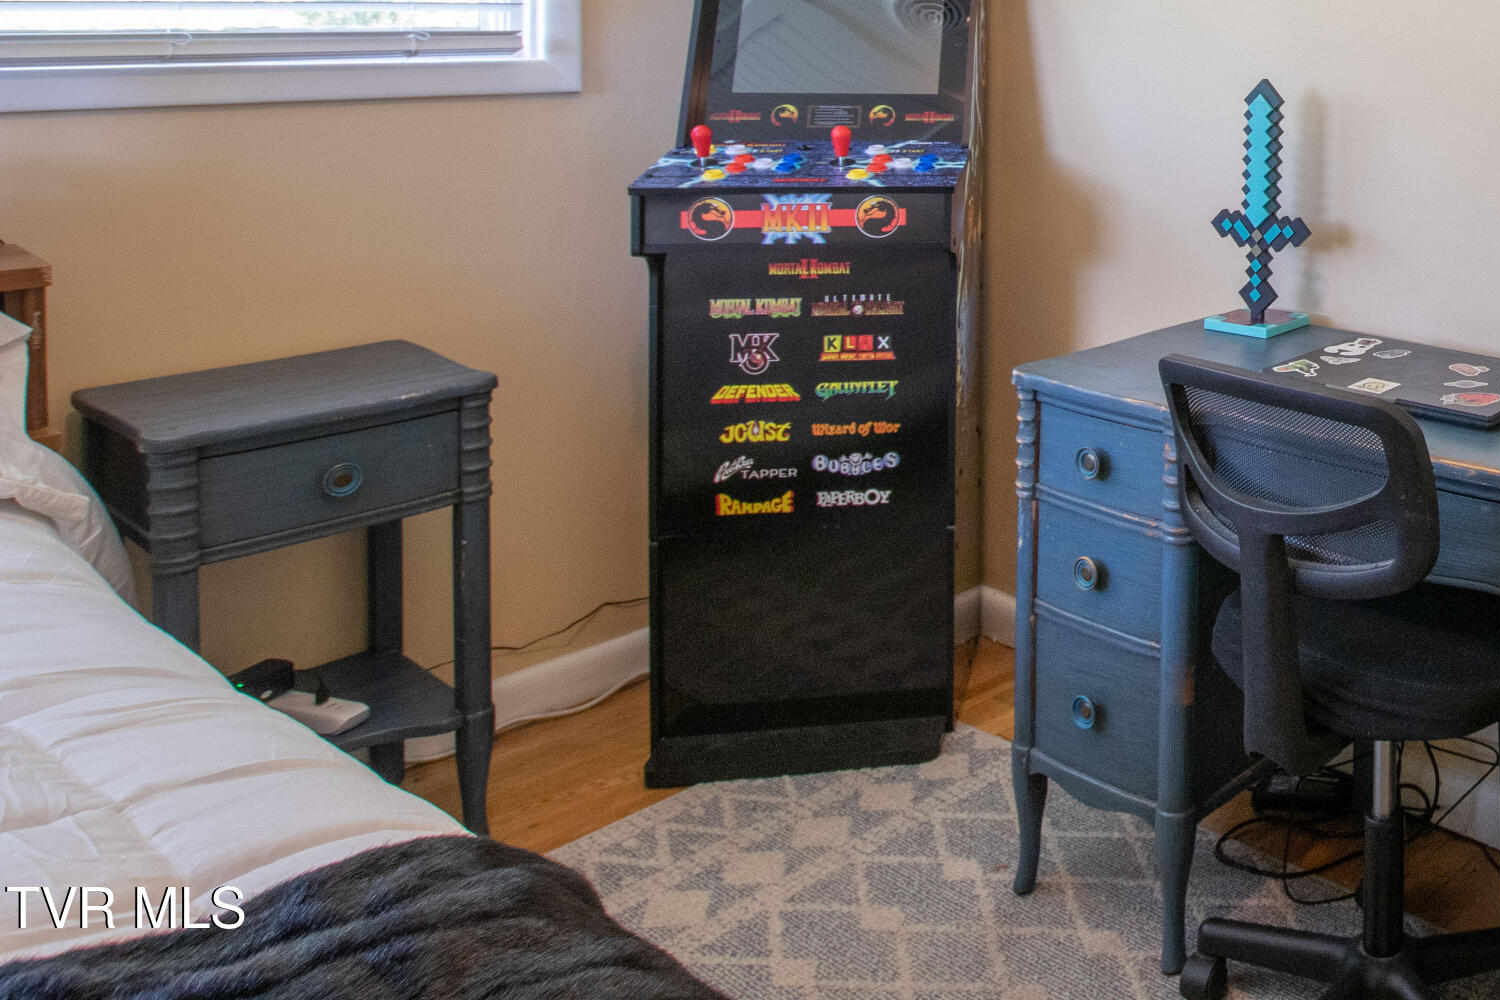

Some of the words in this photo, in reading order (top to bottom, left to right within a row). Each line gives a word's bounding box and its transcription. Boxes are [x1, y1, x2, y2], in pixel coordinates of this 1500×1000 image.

[768, 263, 809, 276] MORTAL
[810, 262, 851, 275] KOMBAT
[823, 335, 890, 353] KLX
[710, 383, 801, 404] DEFENDER
[815, 380, 899, 401] GAUNTLET
[719, 420, 792, 443] JOUST
[811, 422, 856, 436] Wizard
[858, 421, 872, 437] of
[873, 421, 901, 435] Wor
[740, 468, 798, 480] TAPPER
[715, 489, 794, 516] RAMPAGE
[816, 488, 892, 507] PAPERBOY
